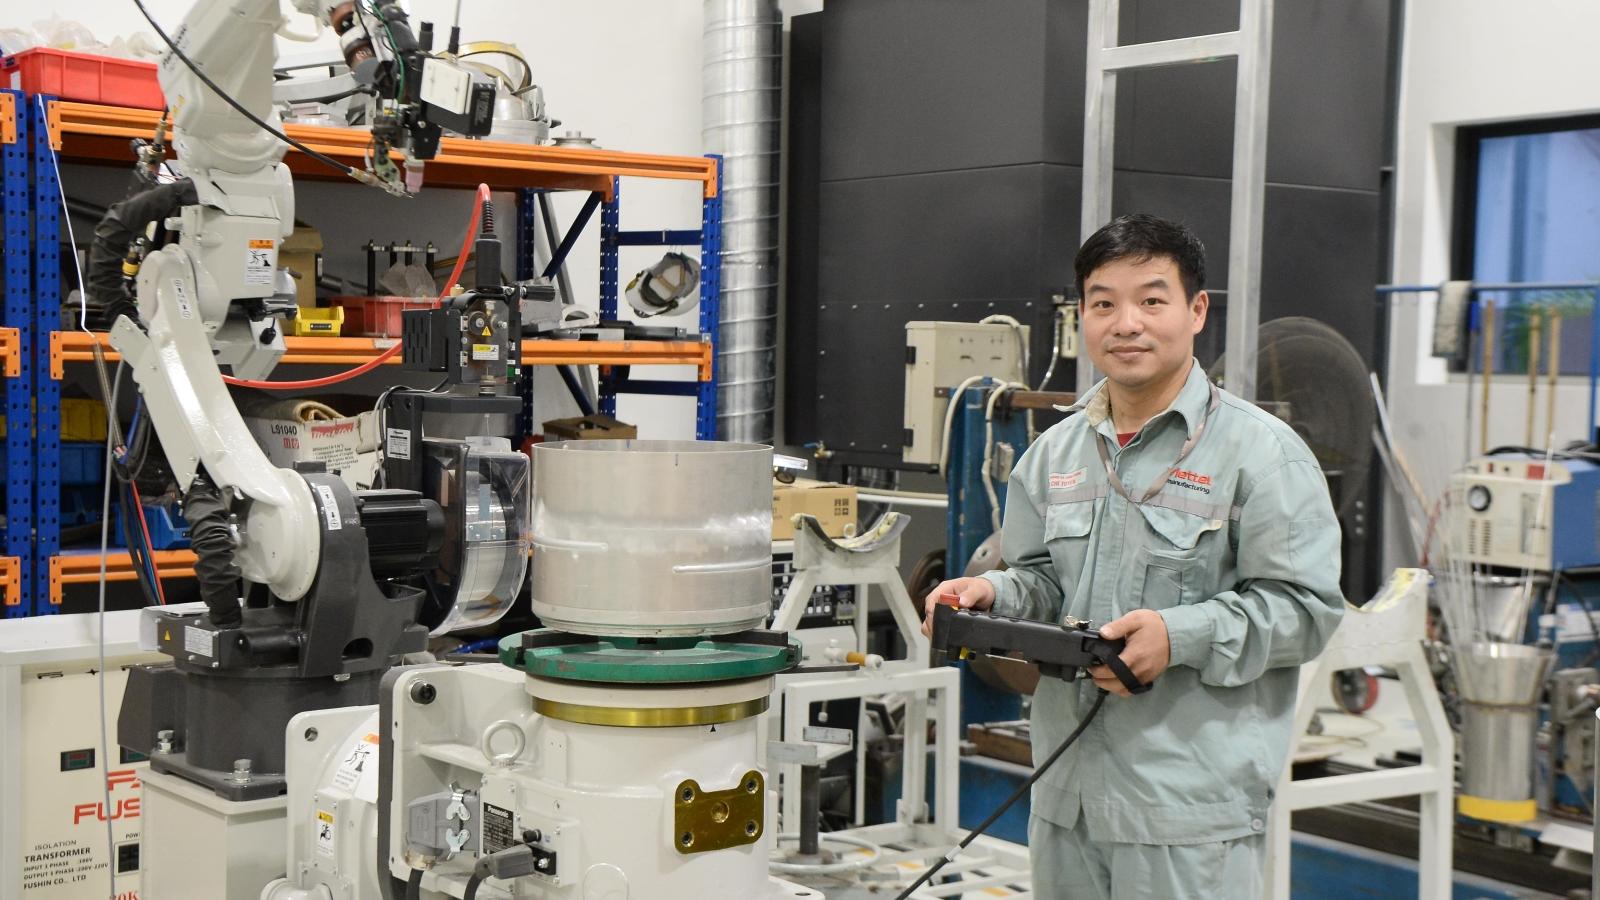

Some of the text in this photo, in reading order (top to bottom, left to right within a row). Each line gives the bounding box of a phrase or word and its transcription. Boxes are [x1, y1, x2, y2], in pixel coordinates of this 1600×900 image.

[125, 832, 141, 840] POW
[34, 839, 77, 851] ISOLATION
[24, 846, 91, 863] TRANSFORMER
[23, 871, 48, 880] OUTPUT
[23, 879, 52, 891] FUSHIN
